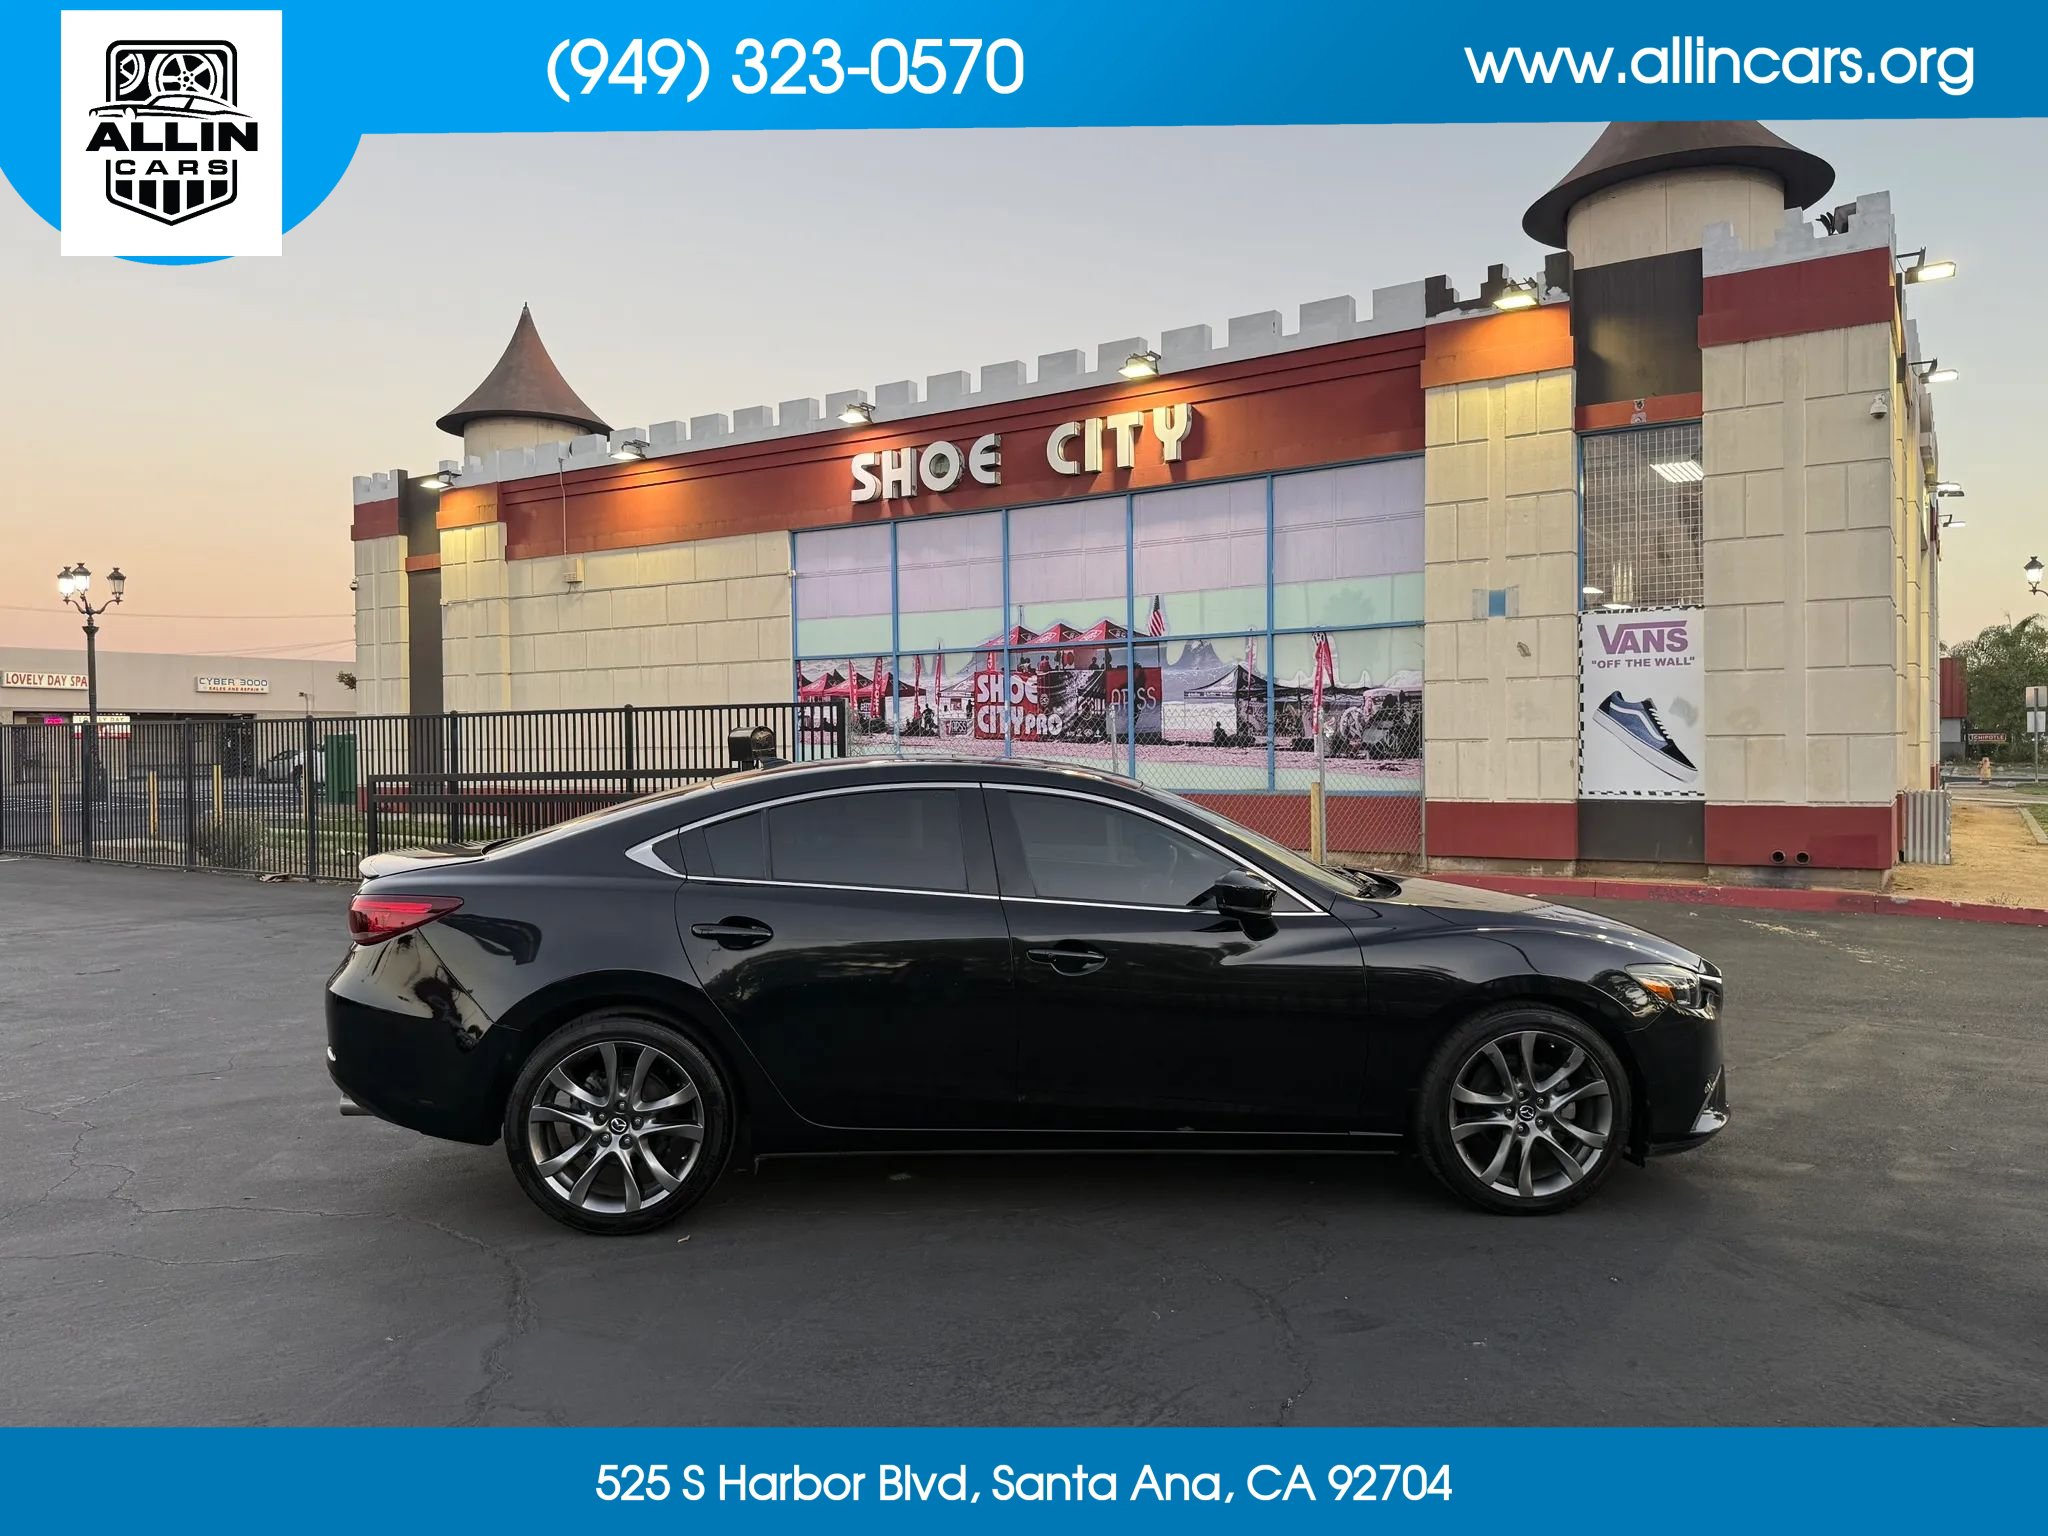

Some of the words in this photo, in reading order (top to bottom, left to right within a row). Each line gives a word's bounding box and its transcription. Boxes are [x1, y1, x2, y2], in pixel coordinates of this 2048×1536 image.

[851, 432, 1001, 502] SHOE
[1047, 403, 1193, 475] CITY
[1597, 620, 1689, 655] VANS
[1592, 660, 1621, 669] "OFF
[1625, 659, 1651, 668] THE
[1655, 656, 1695, 667] WALL"
[6, 673, 44, 686] LOVELY
[47, 675, 67, 687] DAY
[71, 676, 88, 687] SPA
[199, 678, 235, 686] CYBER
[239, 679, 268, 687] 3000
[977, 674, 1038, 704] SHOE
